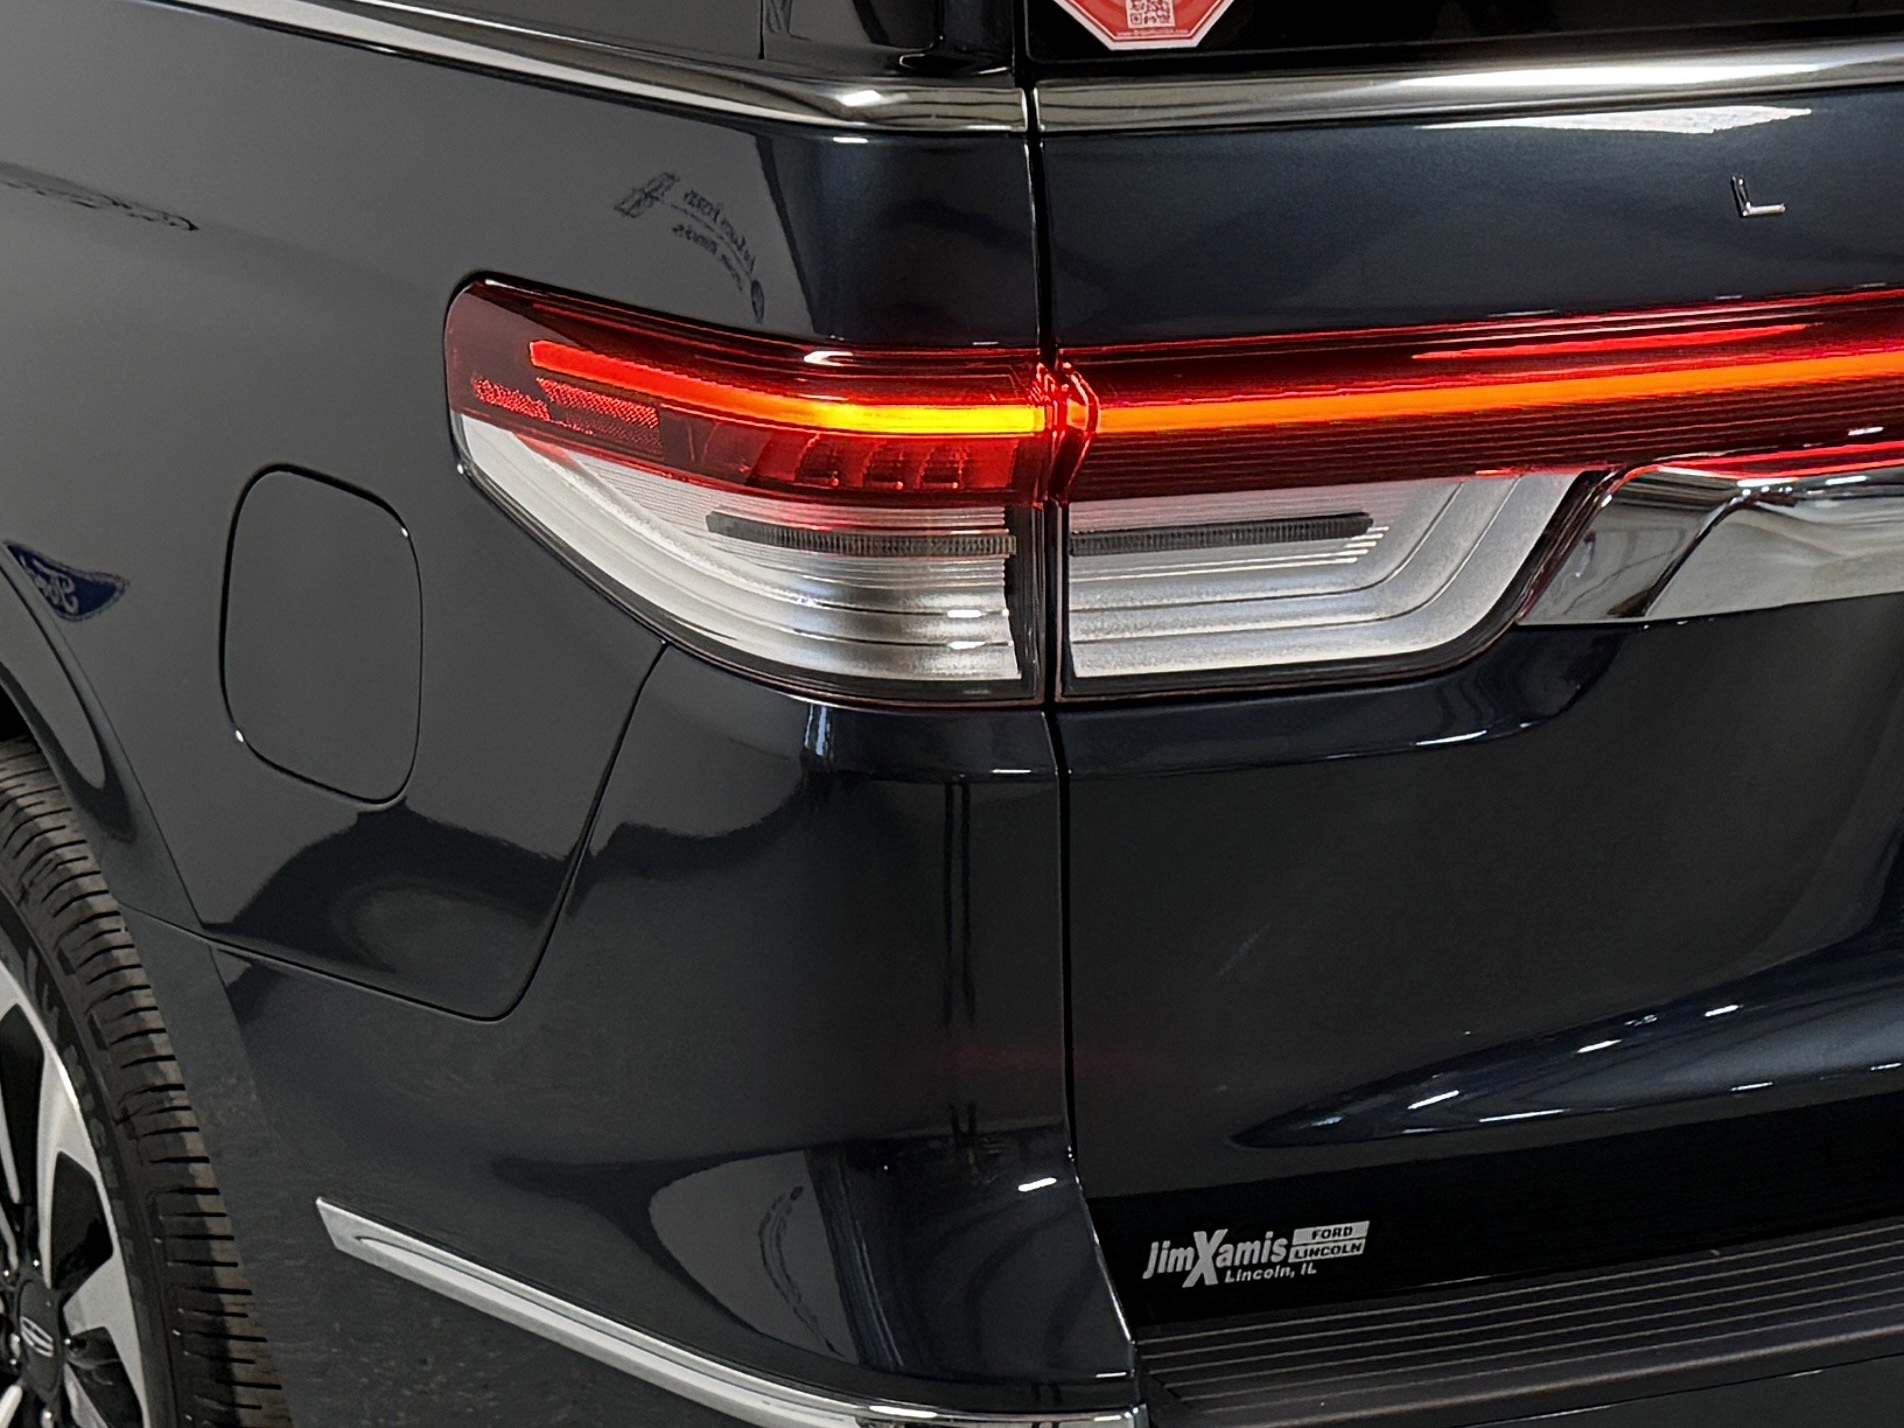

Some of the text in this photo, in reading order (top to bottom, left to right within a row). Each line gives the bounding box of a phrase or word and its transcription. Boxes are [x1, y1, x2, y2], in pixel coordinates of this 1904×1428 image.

[1311, 1225, 1354, 1241] FORD
[1142, 1228, 1289, 1288] JimXamis
[1294, 1241, 1363, 1260] LINCOLN
[1224, 1262, 1318, 1284] Lincoln, IL
